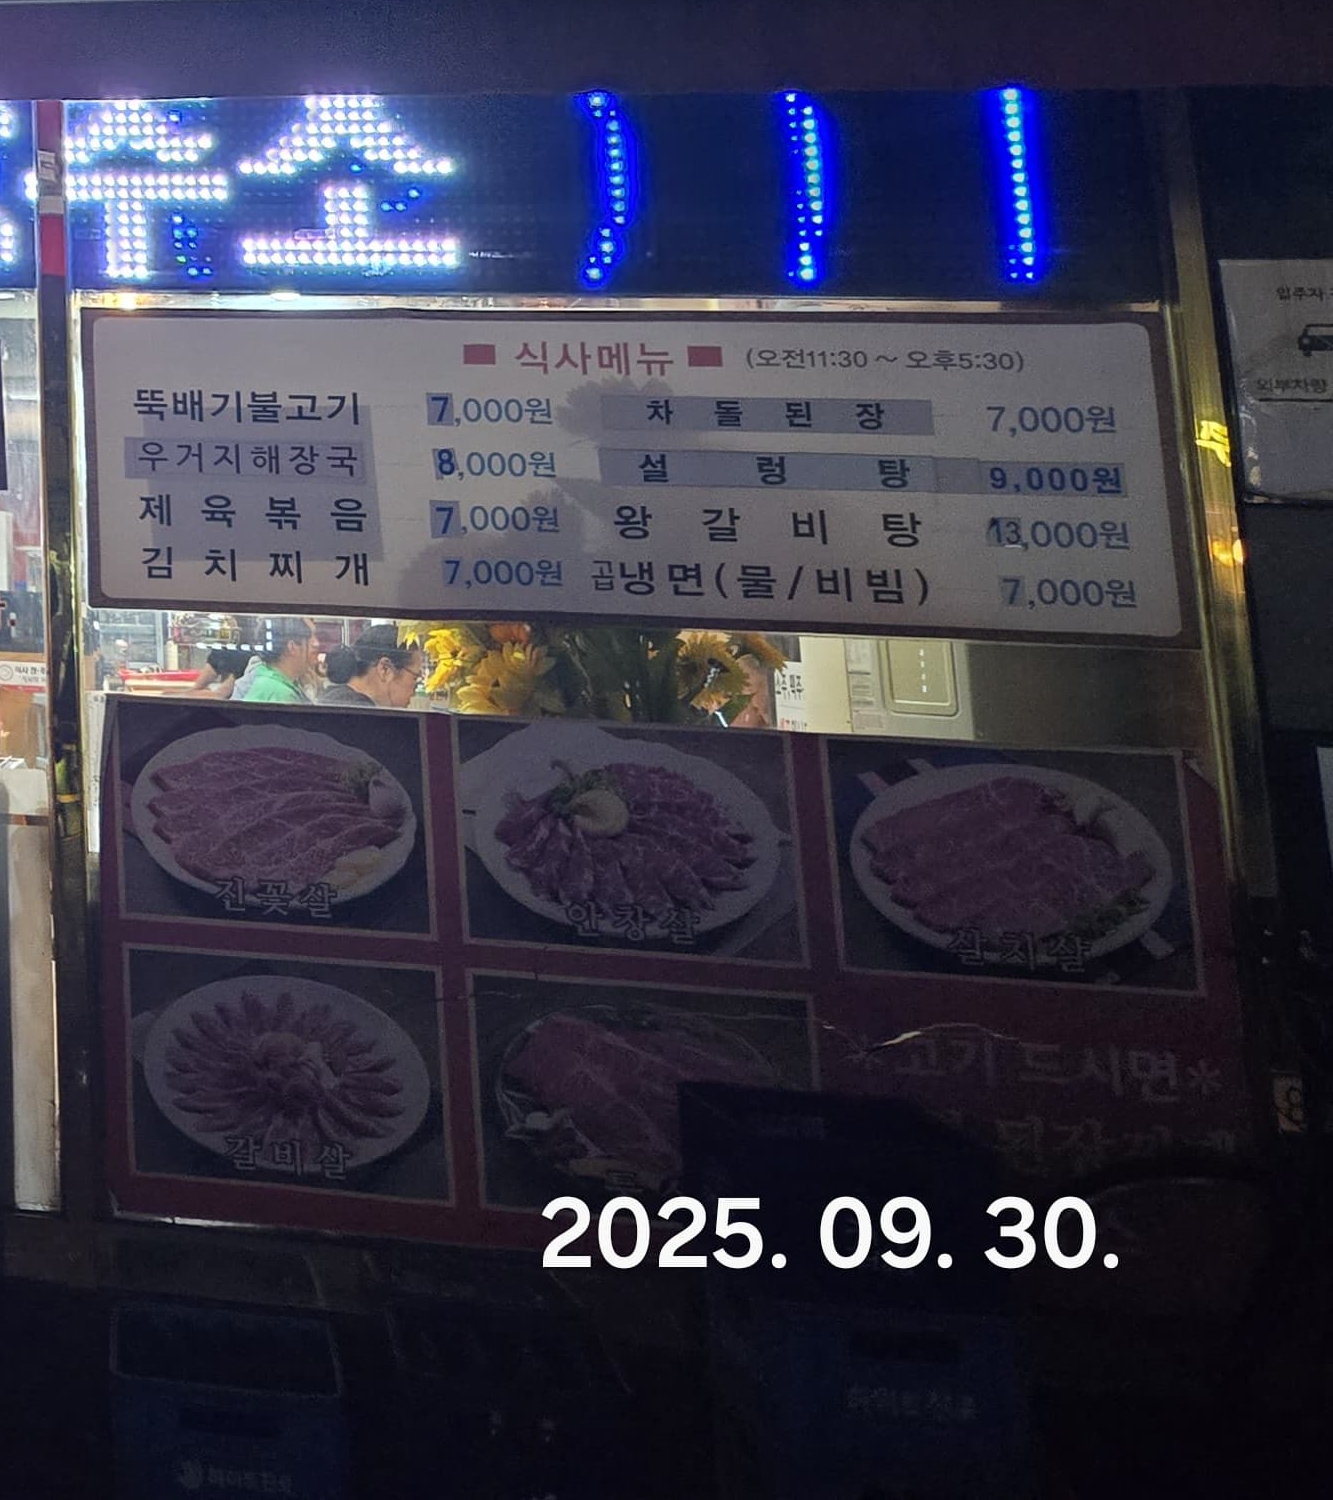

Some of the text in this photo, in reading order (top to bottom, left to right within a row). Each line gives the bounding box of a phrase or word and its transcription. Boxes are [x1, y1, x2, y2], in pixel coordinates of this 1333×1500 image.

[514, 340, 675, 377] 식사메뉴
[133, 389, 554, 426] 뚝배기불고기 7,000원
[985, 405, 1116, 437] 7,000원
[138, 441, 557, 480] 우거지해장국 8,000원
[989, 465, 1123, 495] 9,000원
[434, 505, 560, 536] 7,000원
[443, 559, 564, 590] 7,000원
[1000, 577, 1138, 610] 7,000원
